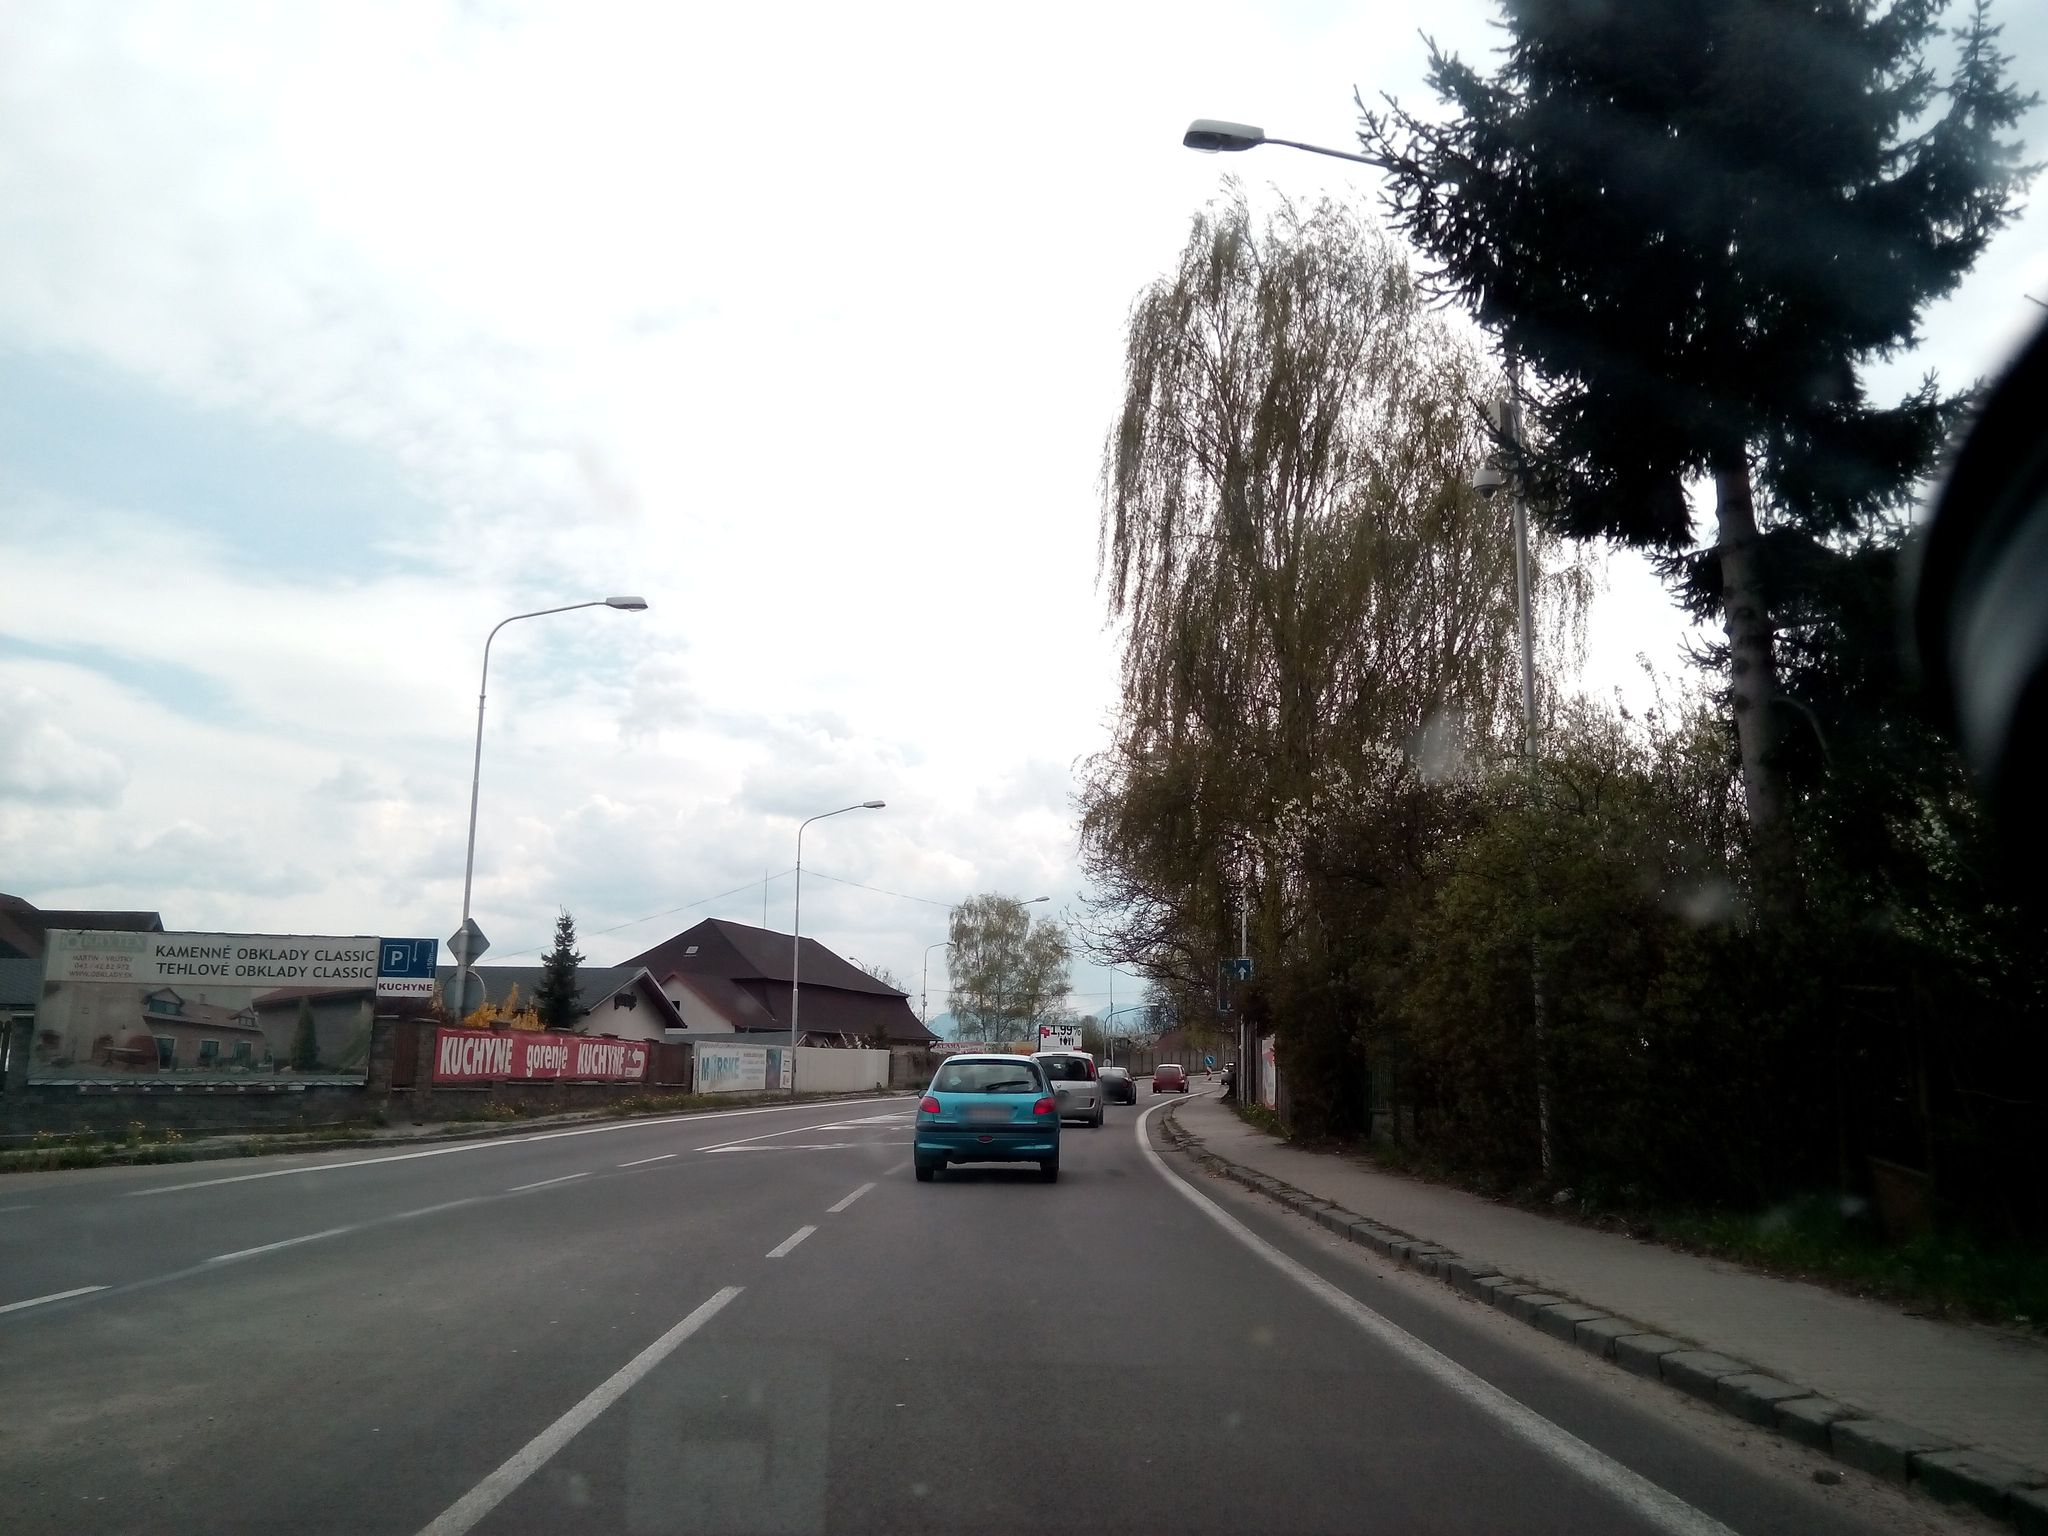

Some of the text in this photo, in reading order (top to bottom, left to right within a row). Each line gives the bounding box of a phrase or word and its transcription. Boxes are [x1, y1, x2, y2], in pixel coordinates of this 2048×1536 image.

[155, 945, 375, 962] KAMENNÉ OBKLADY CLASSIC
[391, 951, 403, 966] P
[156, 962, 373, 978] TEHLOVÉ OBKLADY CLASSIC
[378, 983, 433, 991] KUCHYNE
[440, 1037, 625, 1077] KUCHYNE gorenje KUCHYNE
